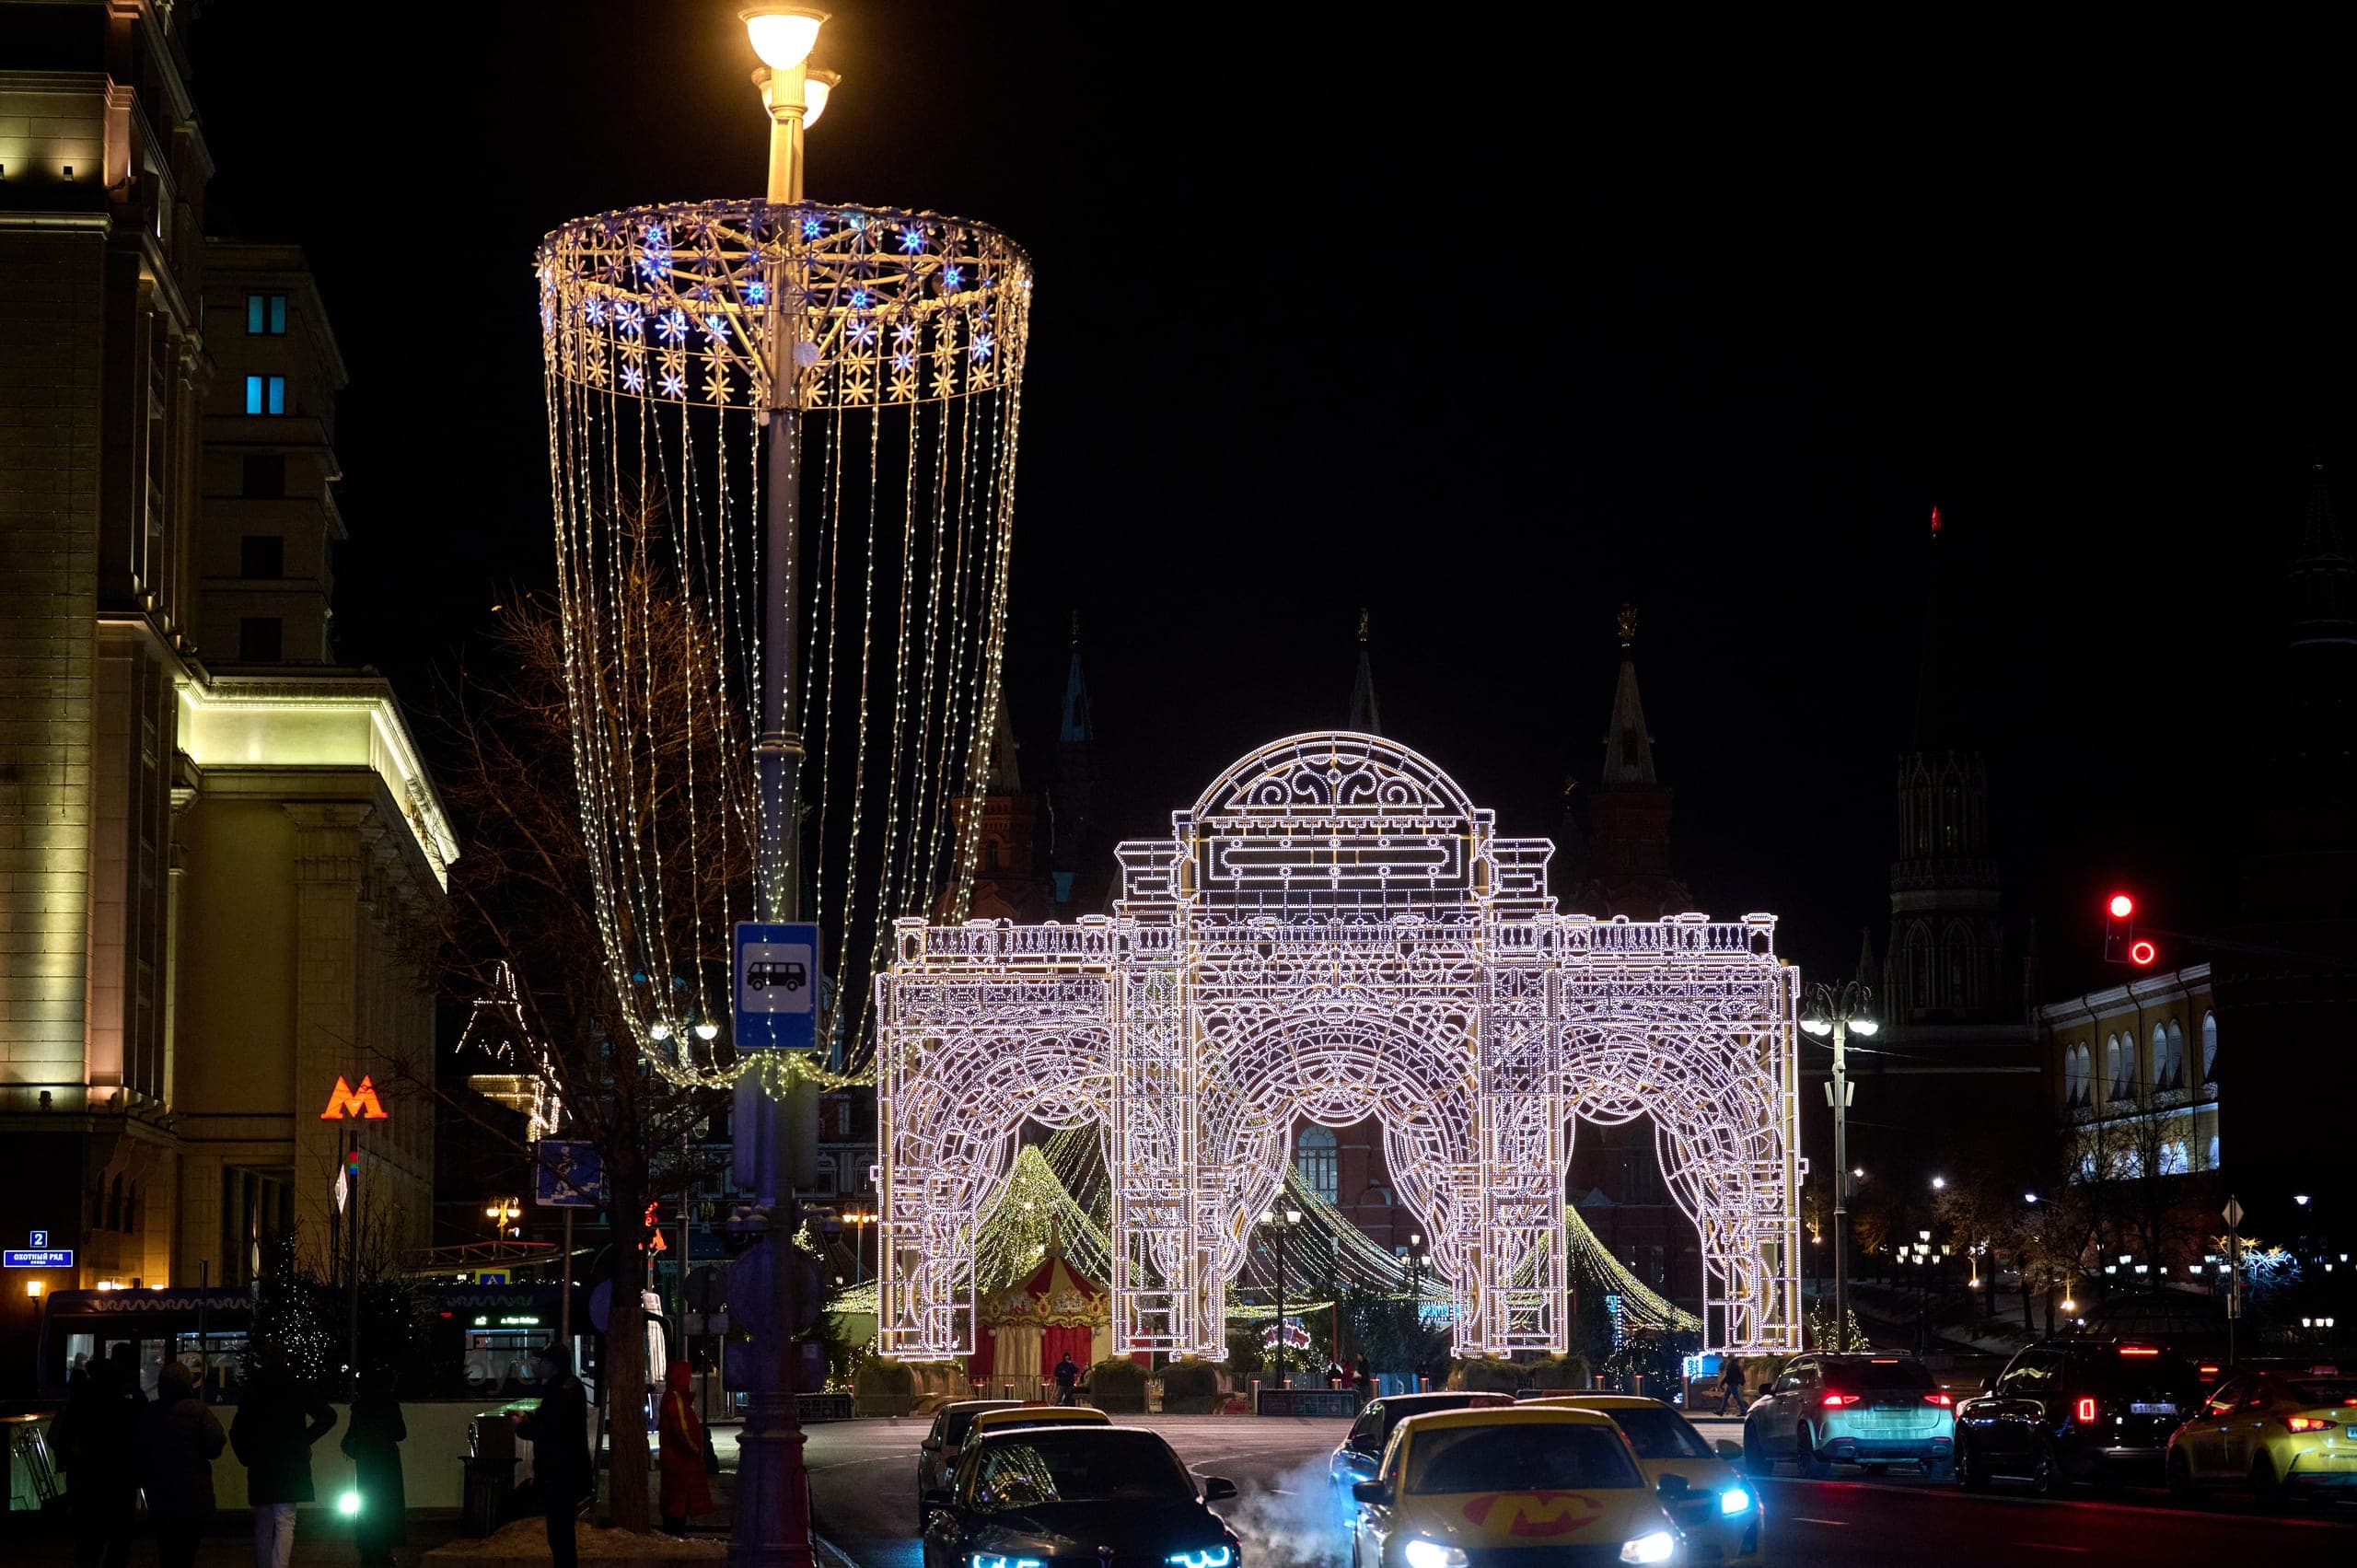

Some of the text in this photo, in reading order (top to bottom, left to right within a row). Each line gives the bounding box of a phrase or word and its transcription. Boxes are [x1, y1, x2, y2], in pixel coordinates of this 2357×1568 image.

[34, 1233, 43, 1246] 2
[14, 1252, 64, 1261] ОХОТНЫЙ РЯД
